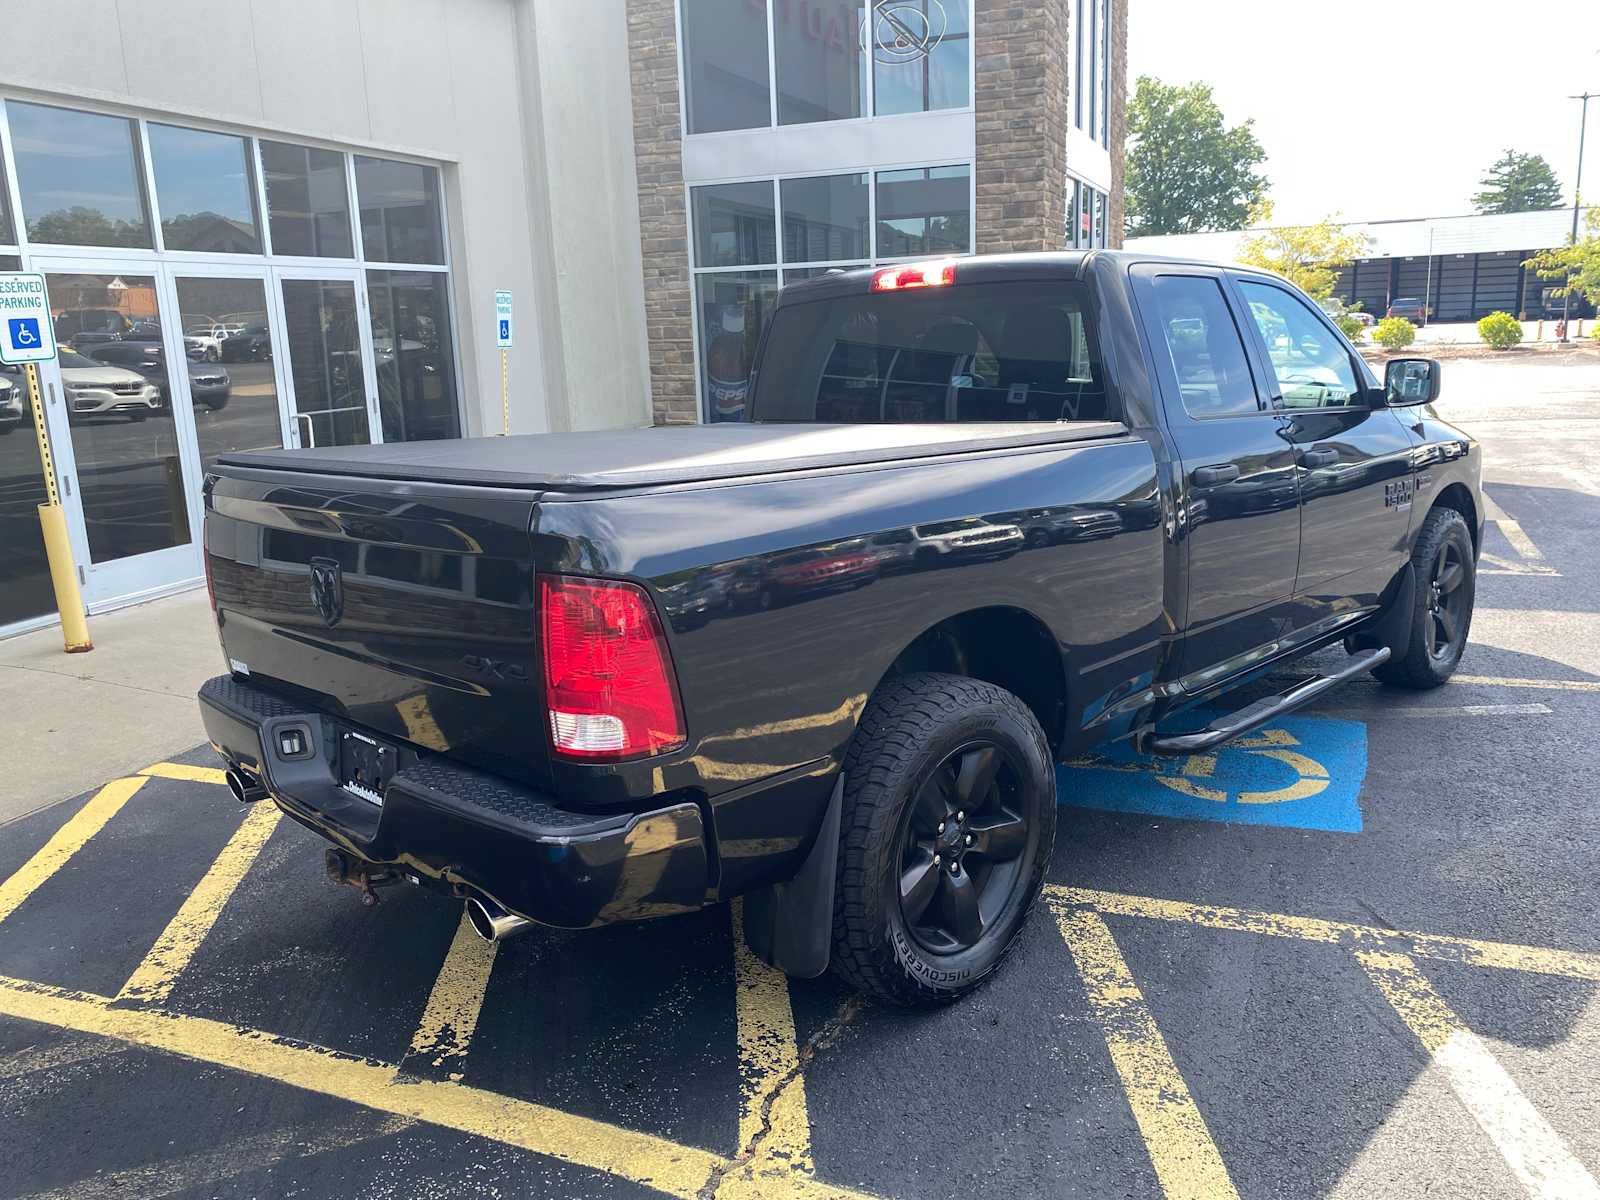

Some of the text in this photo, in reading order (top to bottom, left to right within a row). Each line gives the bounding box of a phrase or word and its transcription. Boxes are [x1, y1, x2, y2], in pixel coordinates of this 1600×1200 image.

[0, 281, 42, 293] ESERVED
[0, 297, 42, 309] PARKING
[1385, 480, 1413, 496] RAM
